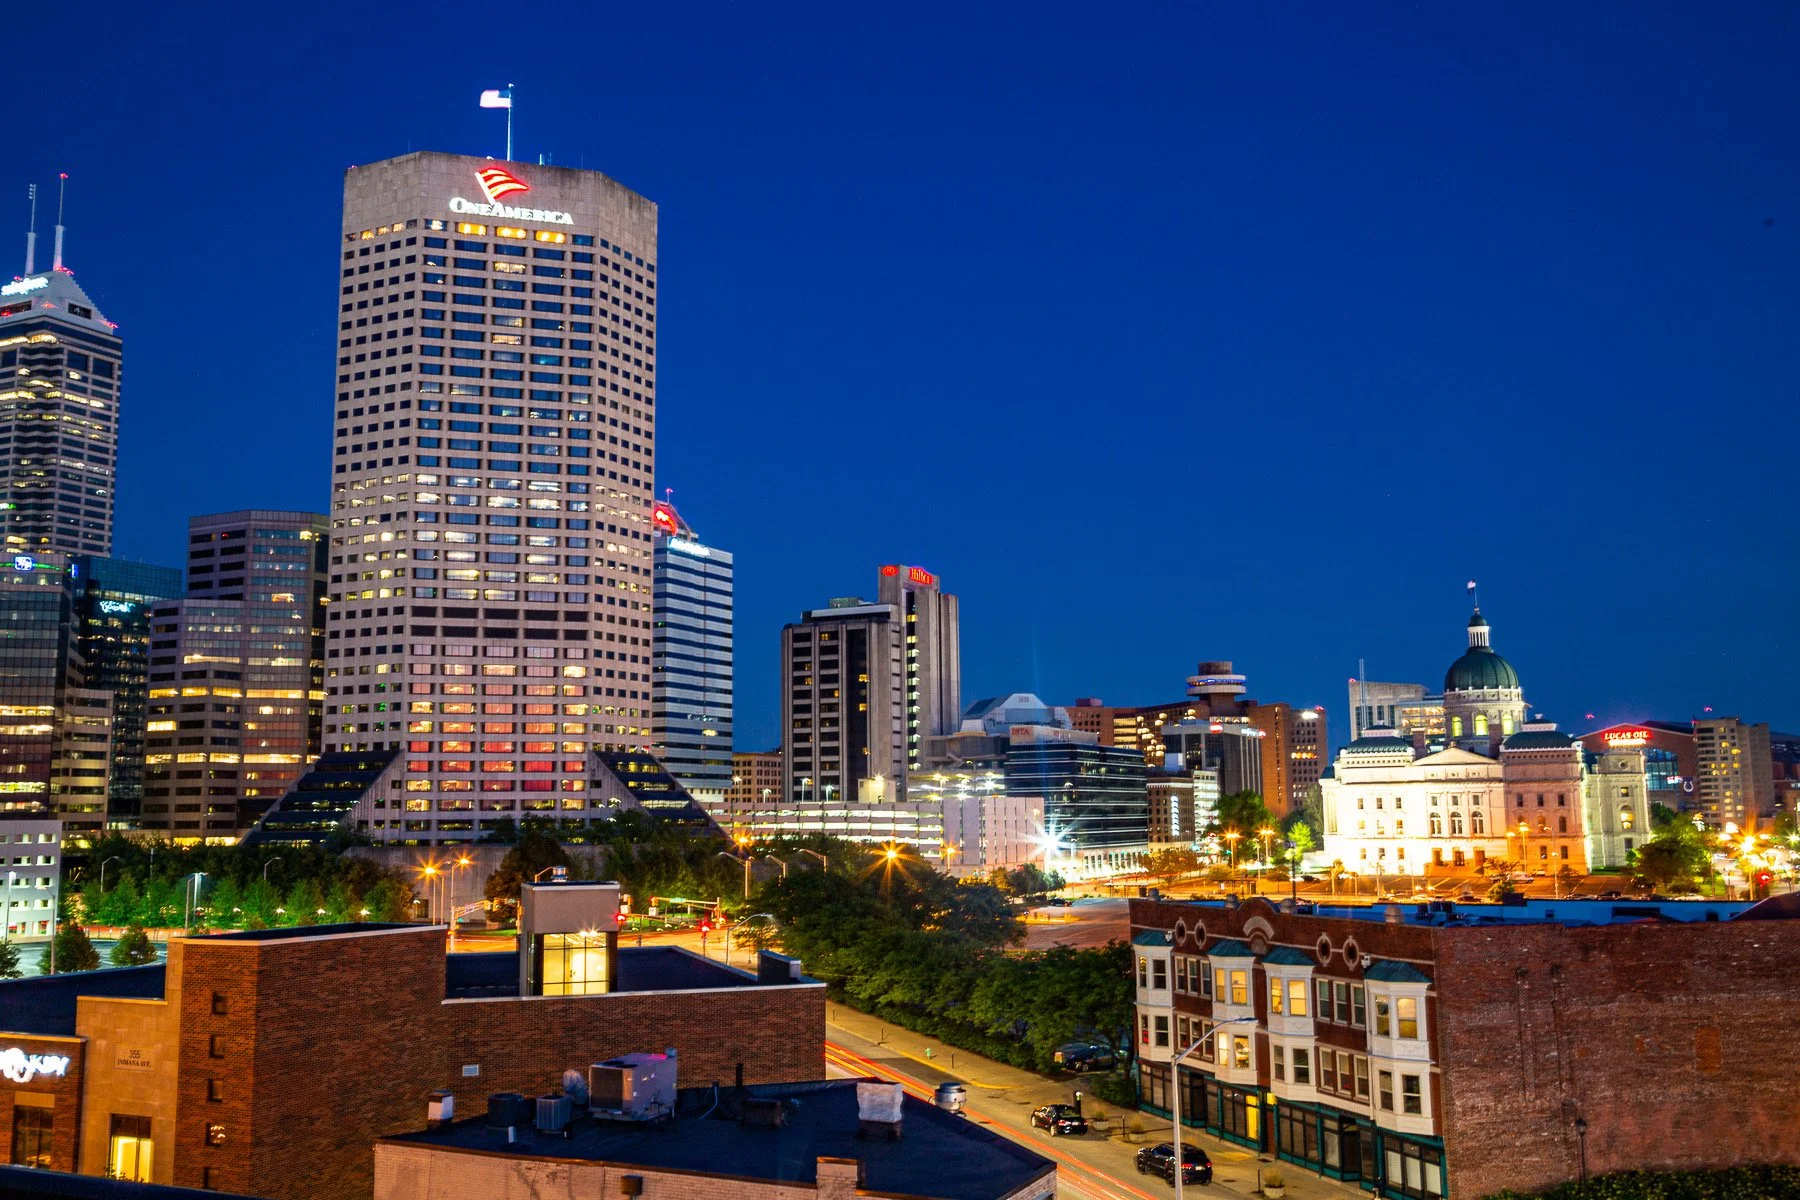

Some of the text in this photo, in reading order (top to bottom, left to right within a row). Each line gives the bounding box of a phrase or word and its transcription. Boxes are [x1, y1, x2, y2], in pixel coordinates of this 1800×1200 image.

[1604, 731, 1649, 740] LUCAS OIL
[129, 1049, 141, 1059] 355
[117, 1059, 139, 1067] INDIANA
